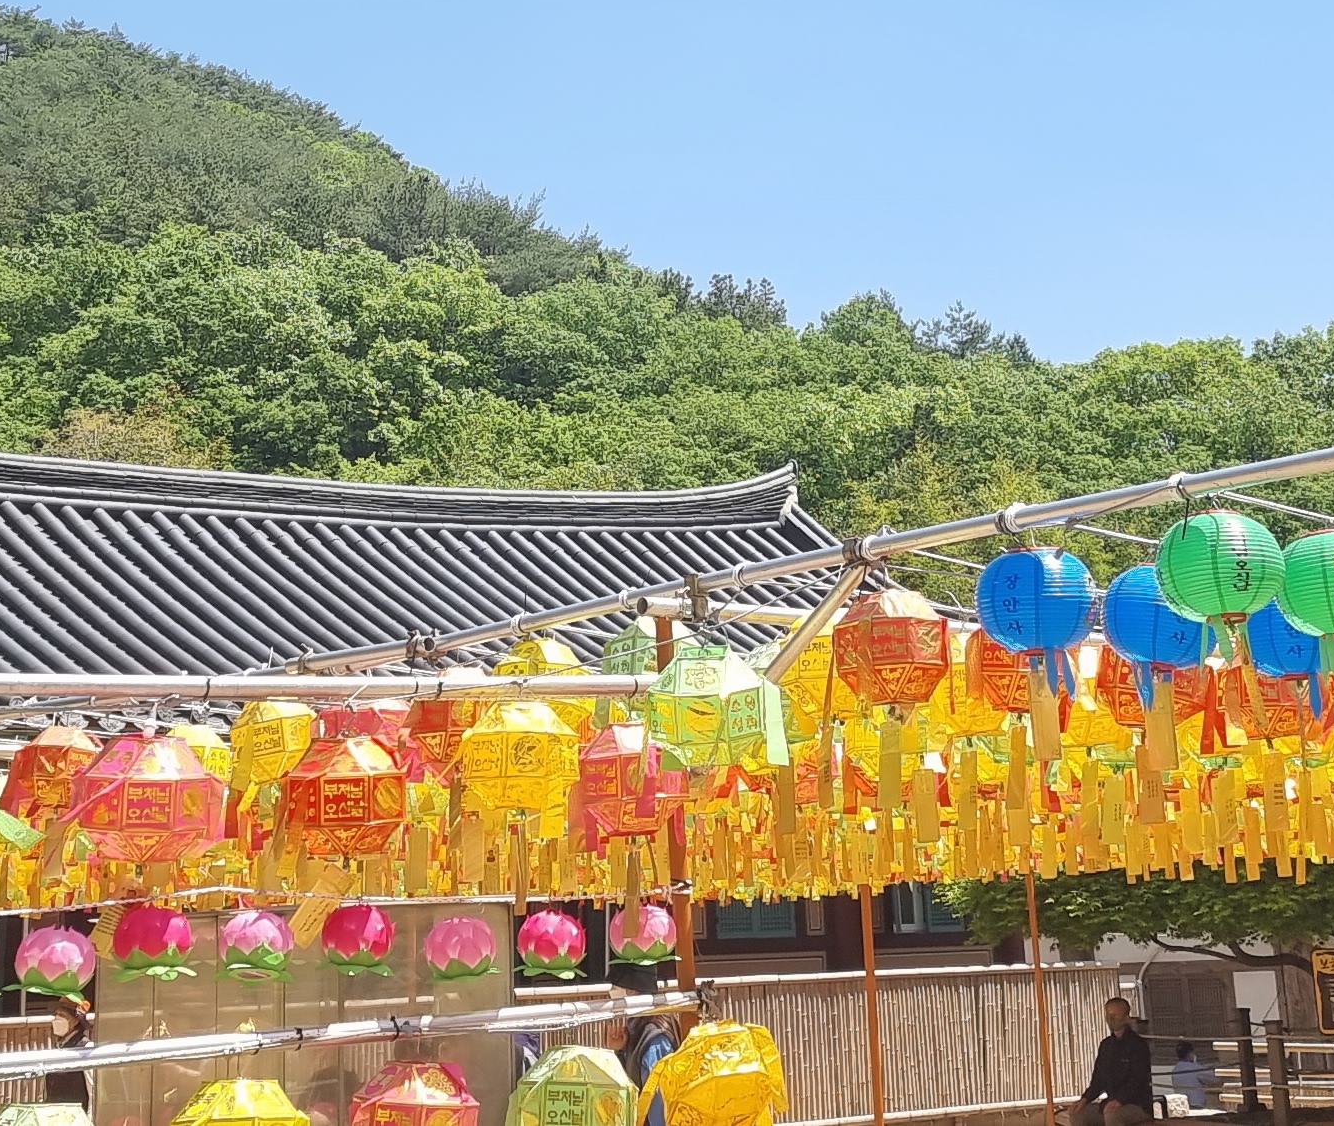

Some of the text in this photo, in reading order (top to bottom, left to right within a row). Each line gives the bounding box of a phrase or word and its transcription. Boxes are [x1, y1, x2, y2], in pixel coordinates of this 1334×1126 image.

[1002, 574, 1024, 636] 장안사
[128, 786, 171, 804] 부처님
[324, 781, 365, 800] 부처님
[323, 801, 368, 819] 오신날
[546, 1089, 585, 1107] 부처님
[546, 1108, 585, 1126] 오신날
